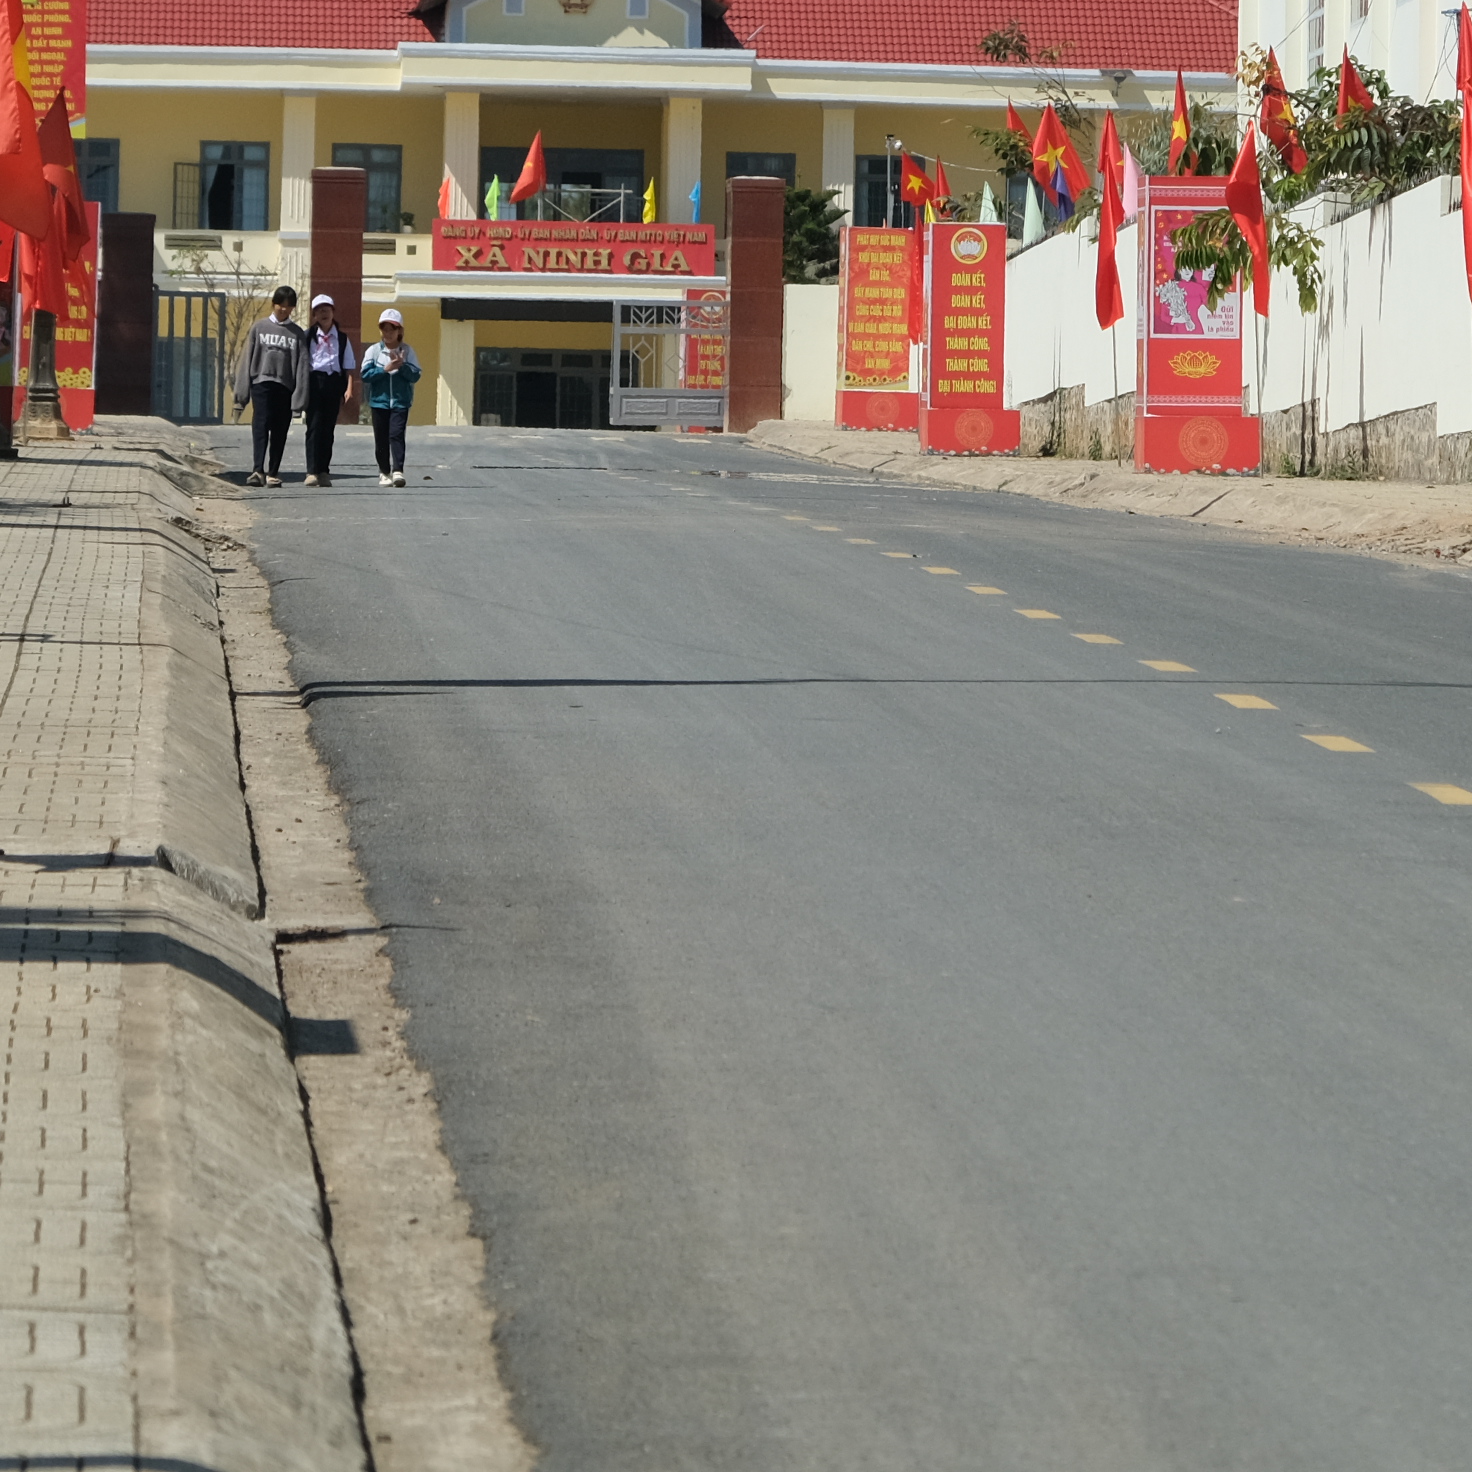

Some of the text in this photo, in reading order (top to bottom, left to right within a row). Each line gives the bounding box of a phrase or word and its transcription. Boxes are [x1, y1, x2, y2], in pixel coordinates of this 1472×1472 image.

[688, 231, 706, 242] NAM
[455, 240, 691, 271] XÃ NINH GIA
[945, 334, 968, 350] THÀNH
[945, 356, 968, 372] THÀNH
[952, 377, 974, 393] THÀNH
